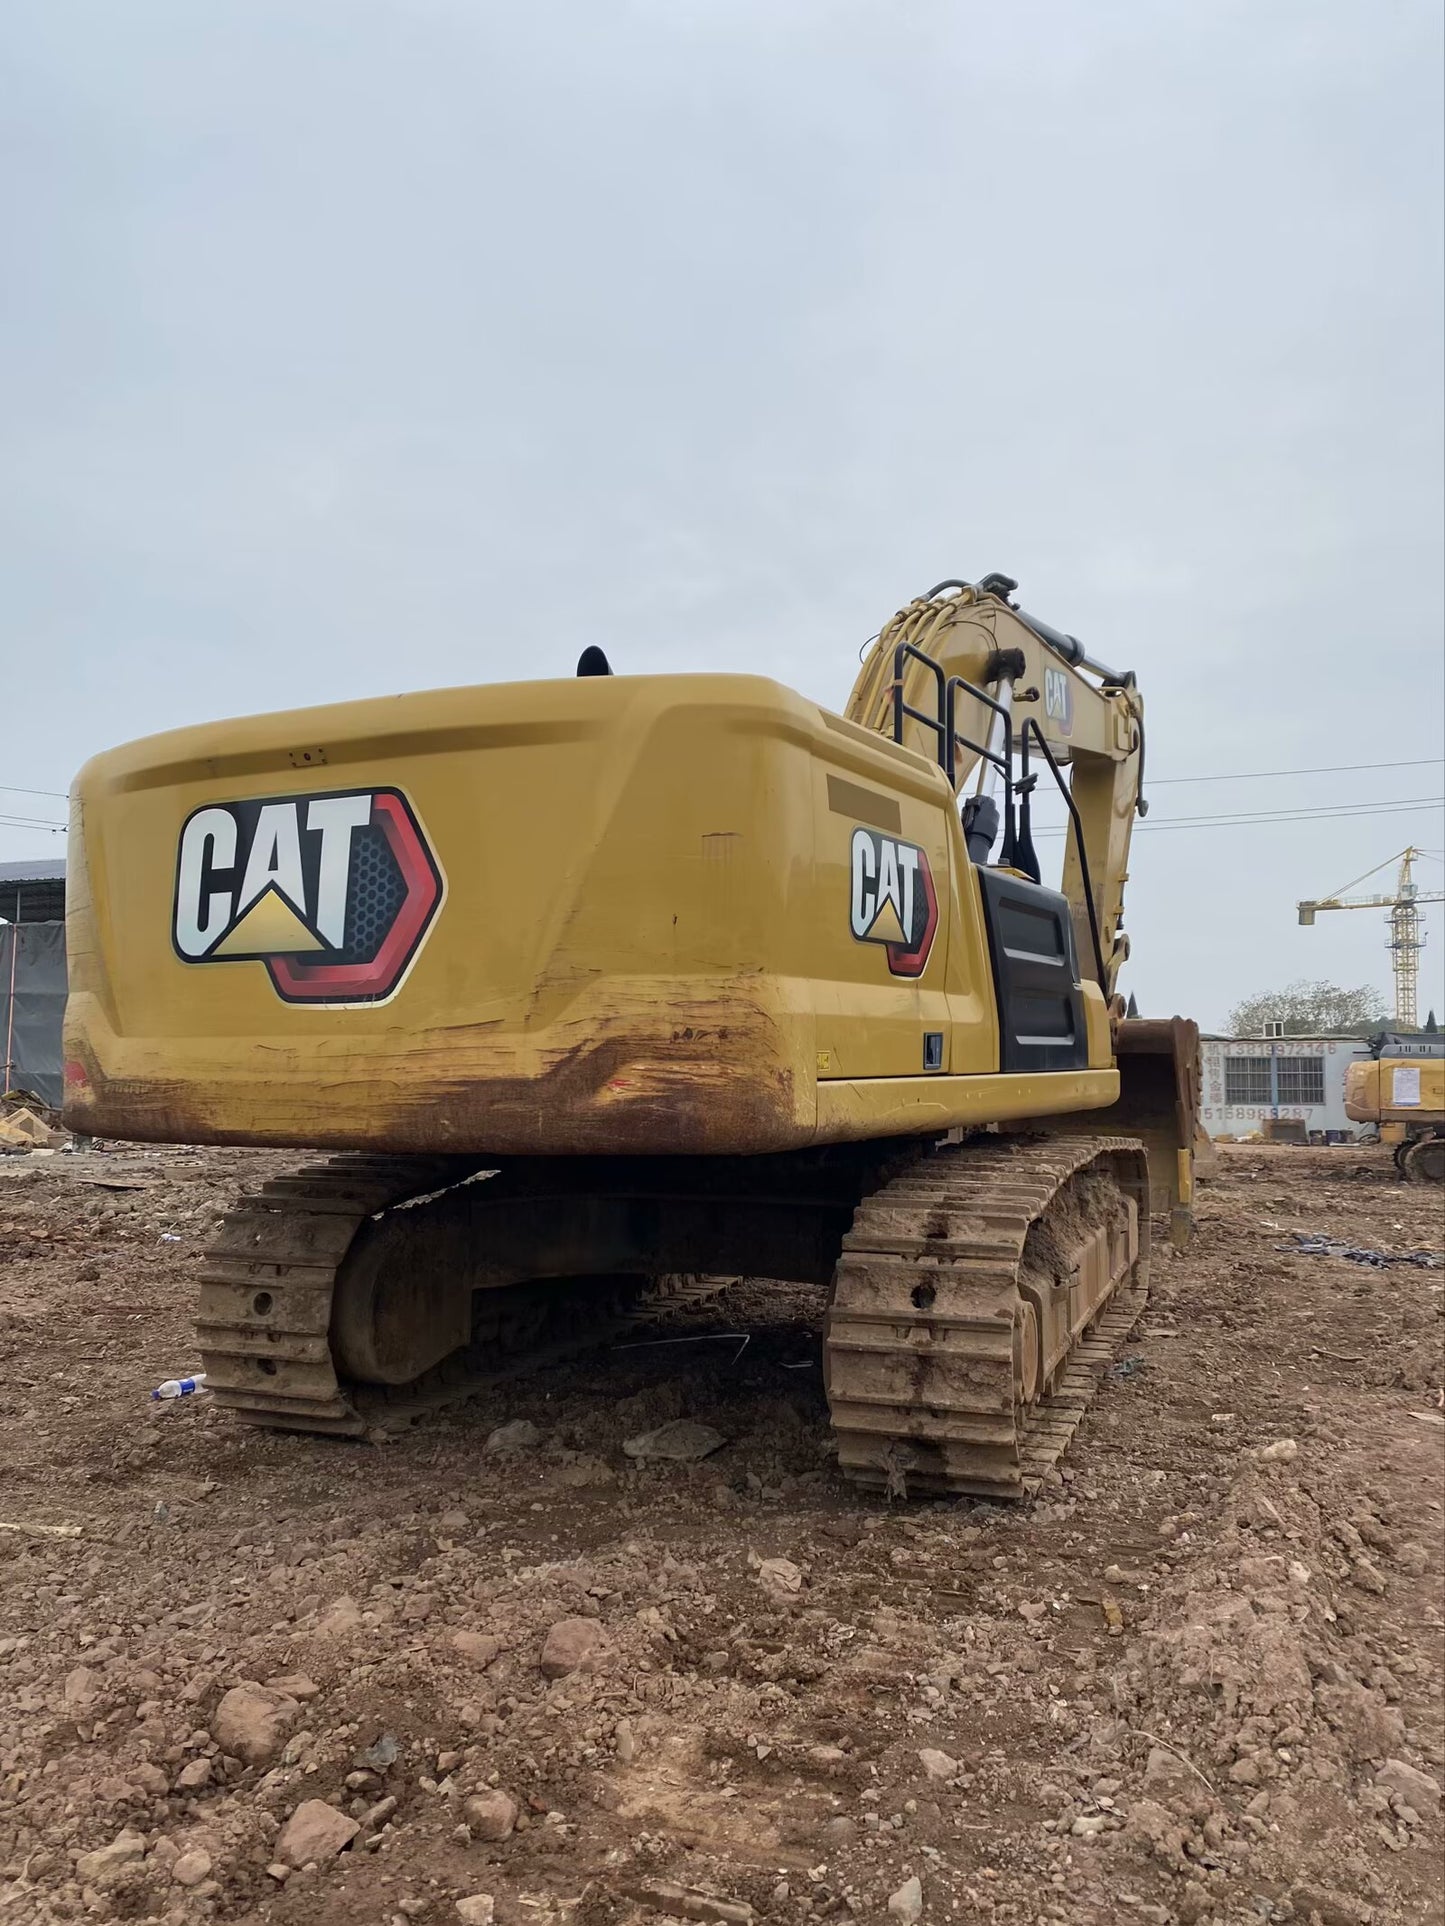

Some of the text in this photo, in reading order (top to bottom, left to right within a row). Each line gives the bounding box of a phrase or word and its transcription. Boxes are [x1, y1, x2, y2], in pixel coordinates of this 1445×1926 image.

[1045, 667, 1067, 721] CAT
[176, 794, 372, 957] CAT
[851, 830, 919, 944] CAT
